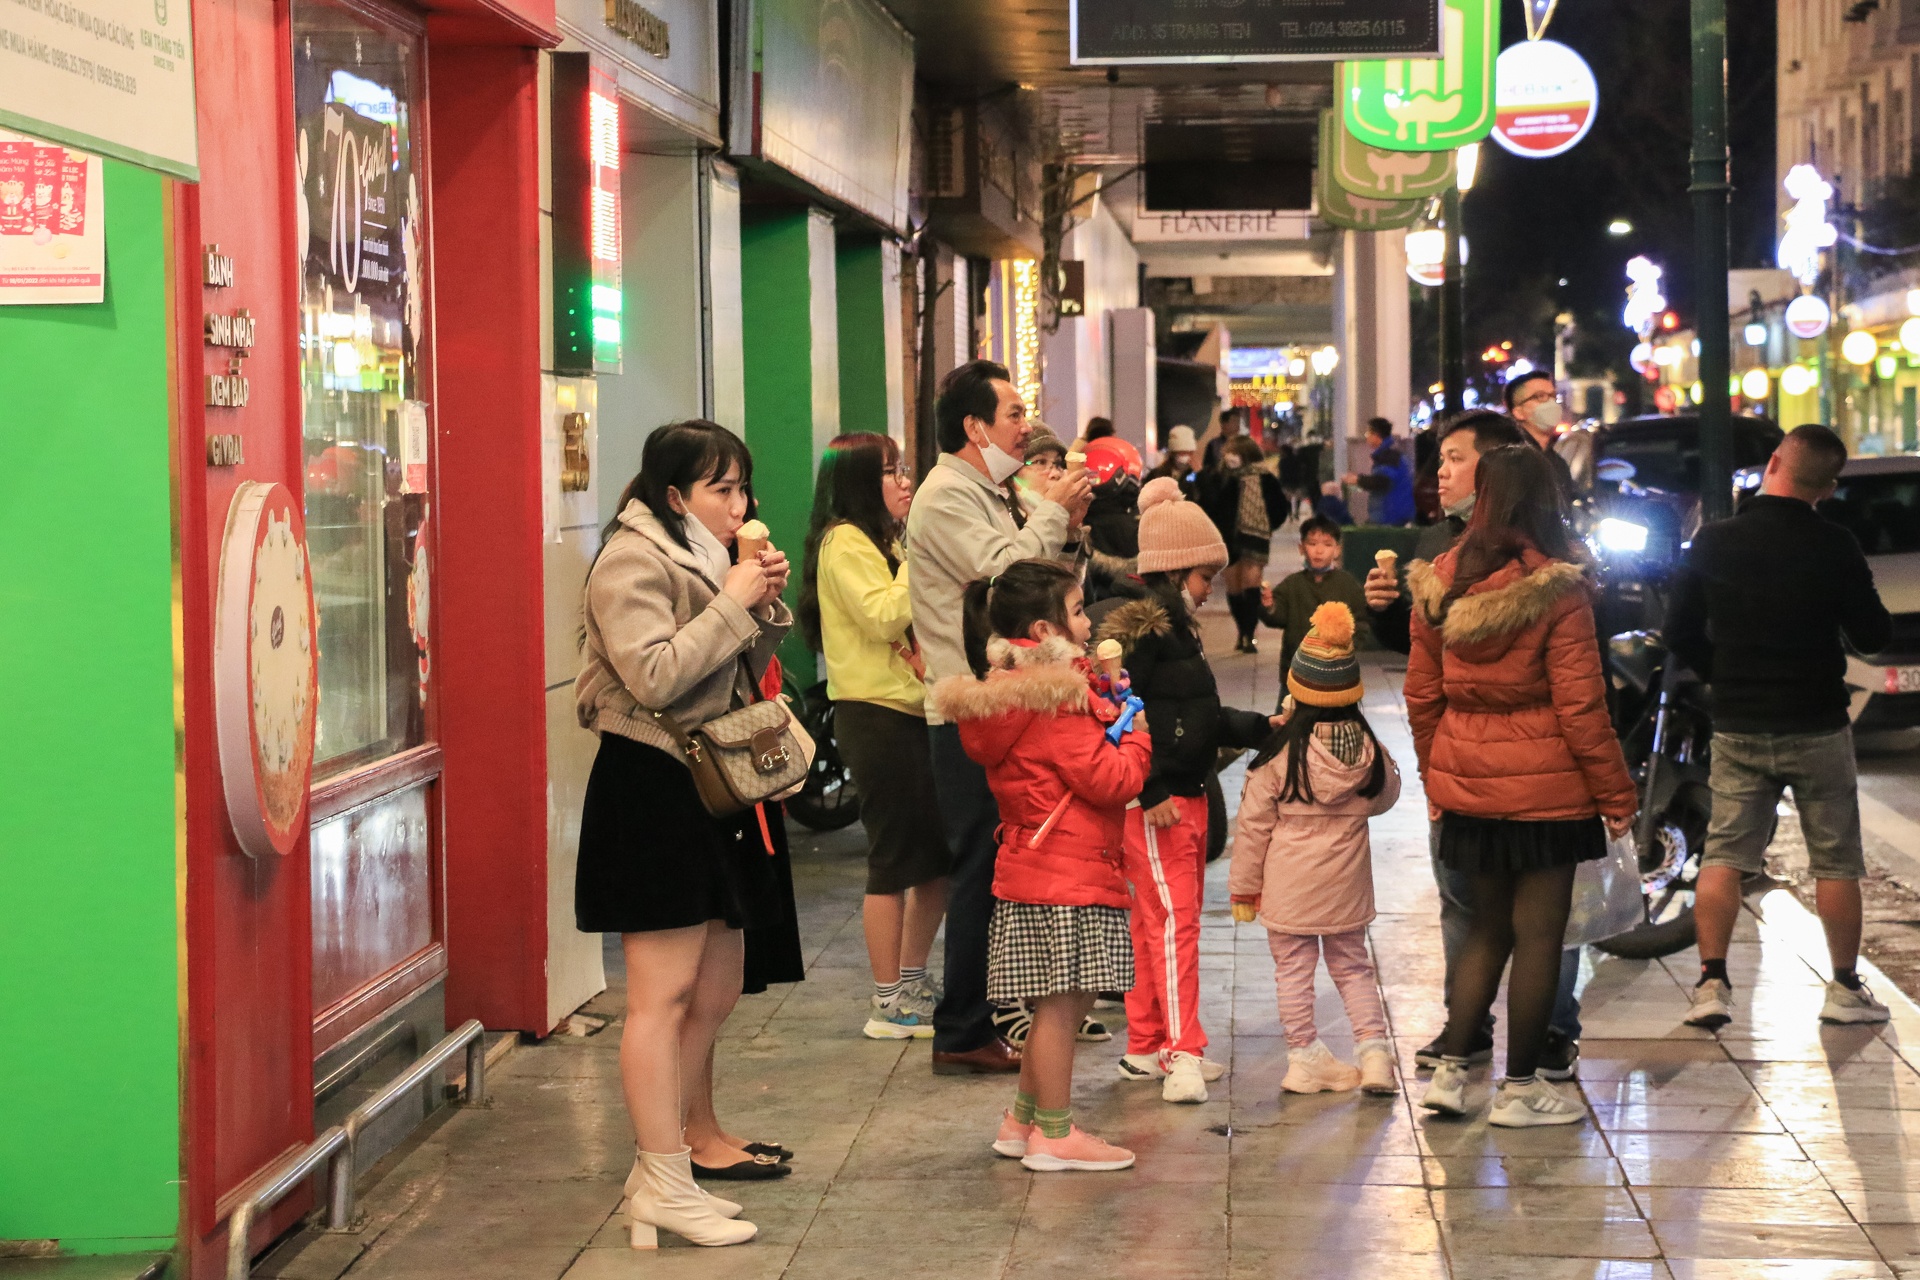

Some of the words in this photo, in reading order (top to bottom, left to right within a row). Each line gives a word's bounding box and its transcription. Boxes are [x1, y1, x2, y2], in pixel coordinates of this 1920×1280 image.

[209, 313, 231, 346] SINH
[207, 374, 231, 407] KEM
[208, 434, 246, 465] GIVRAL
